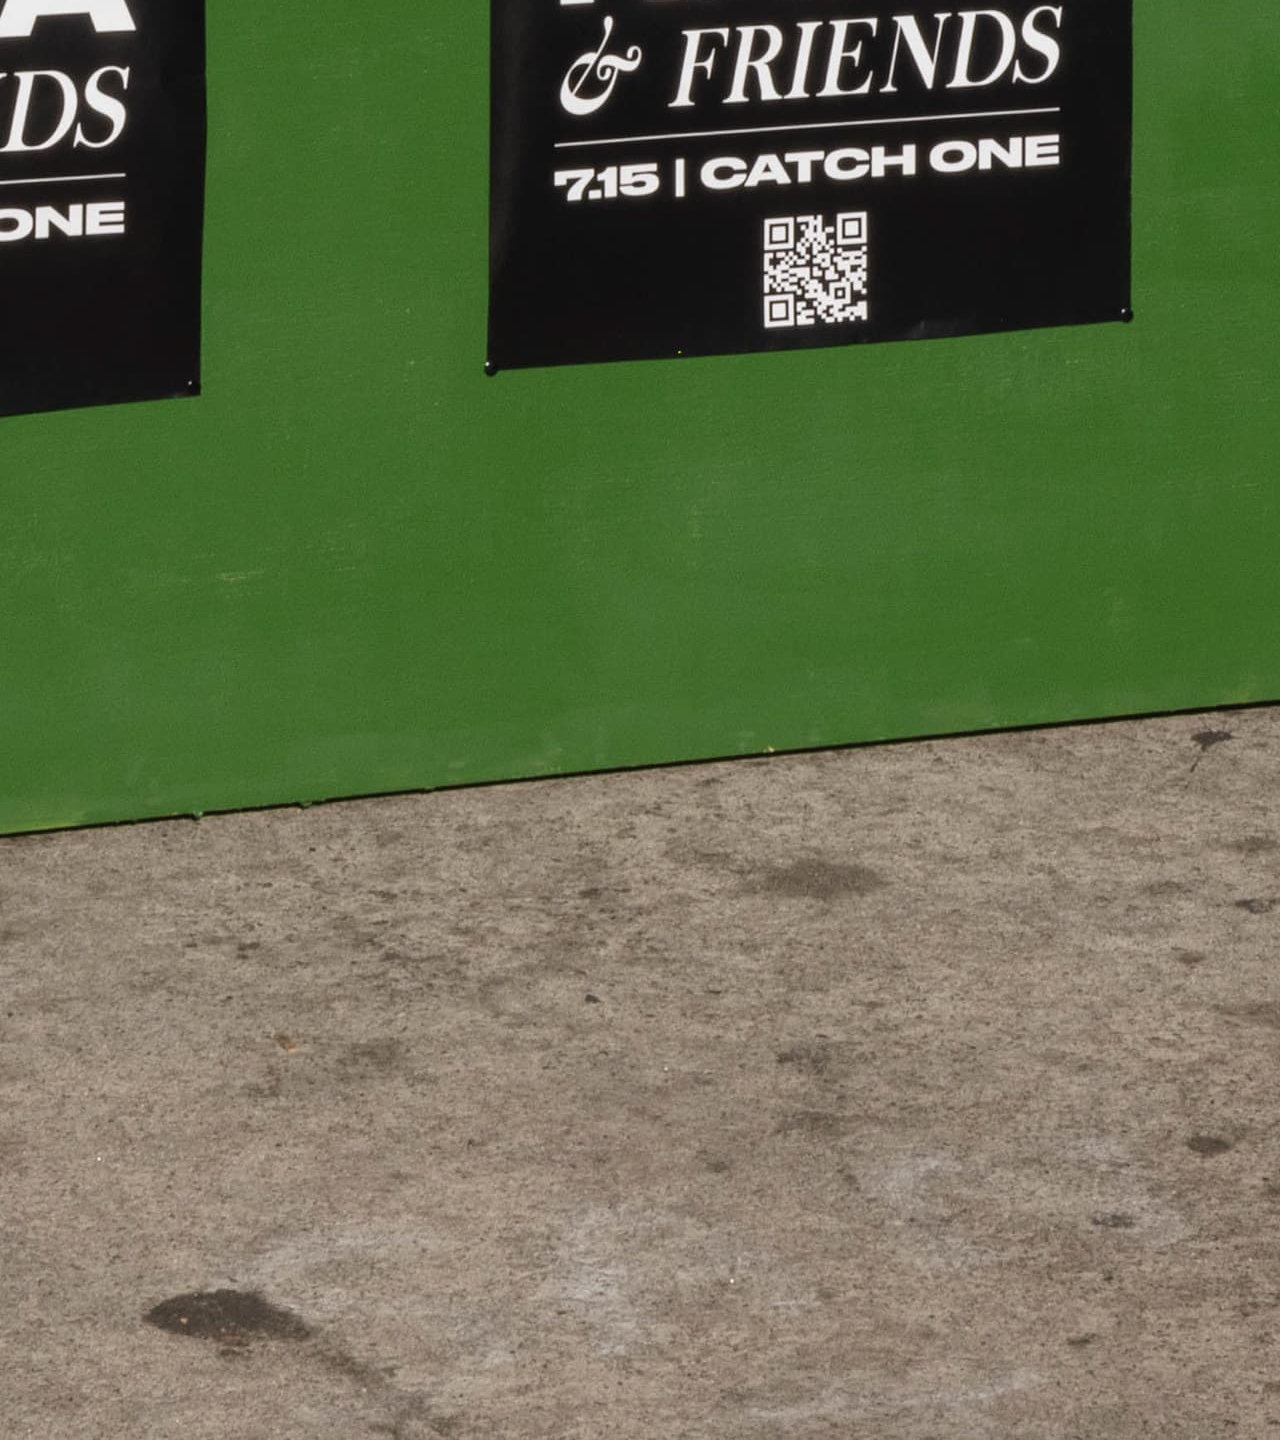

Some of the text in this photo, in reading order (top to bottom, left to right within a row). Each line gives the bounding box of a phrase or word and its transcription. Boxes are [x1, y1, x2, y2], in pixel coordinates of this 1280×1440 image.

[559, 5, 1065, 116] & FRIENDS
[700, 143, 916, 190] CATCH
[929, 134, 1061, 173] ONE
